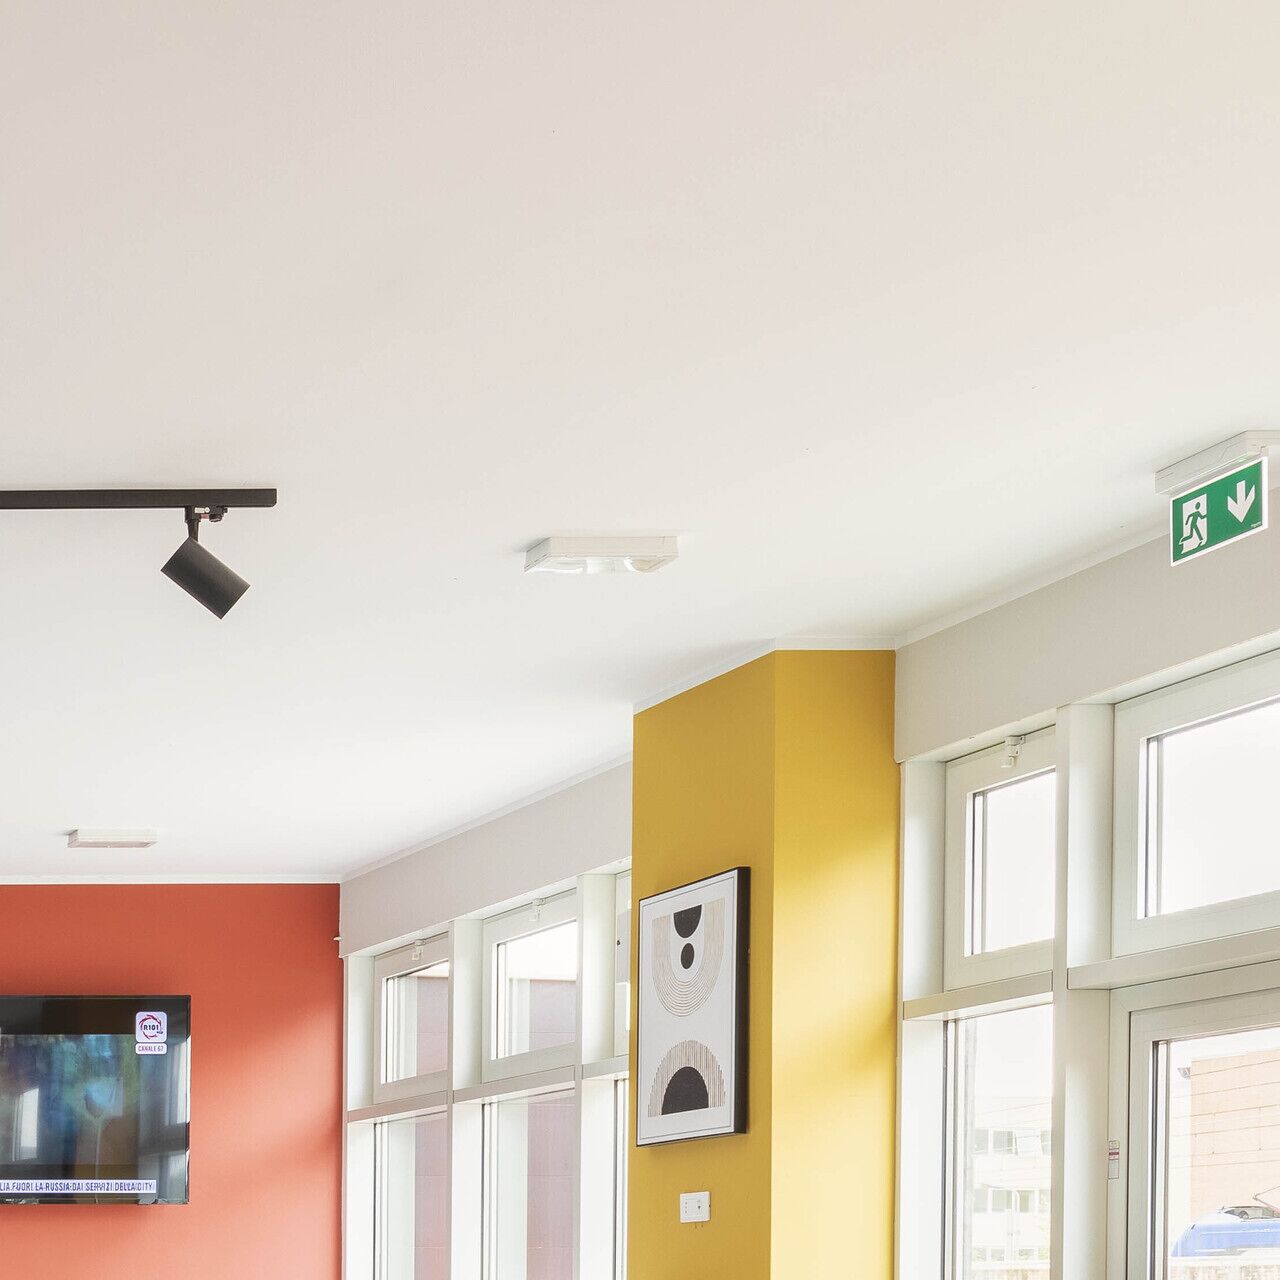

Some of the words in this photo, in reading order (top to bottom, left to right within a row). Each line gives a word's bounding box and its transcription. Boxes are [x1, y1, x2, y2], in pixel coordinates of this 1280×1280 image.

[12, 1183, 33, 1191] FUORI
[45, 1183, 70, 1191] RUSSIA
[137, 1183, 153, 1191] CITY
